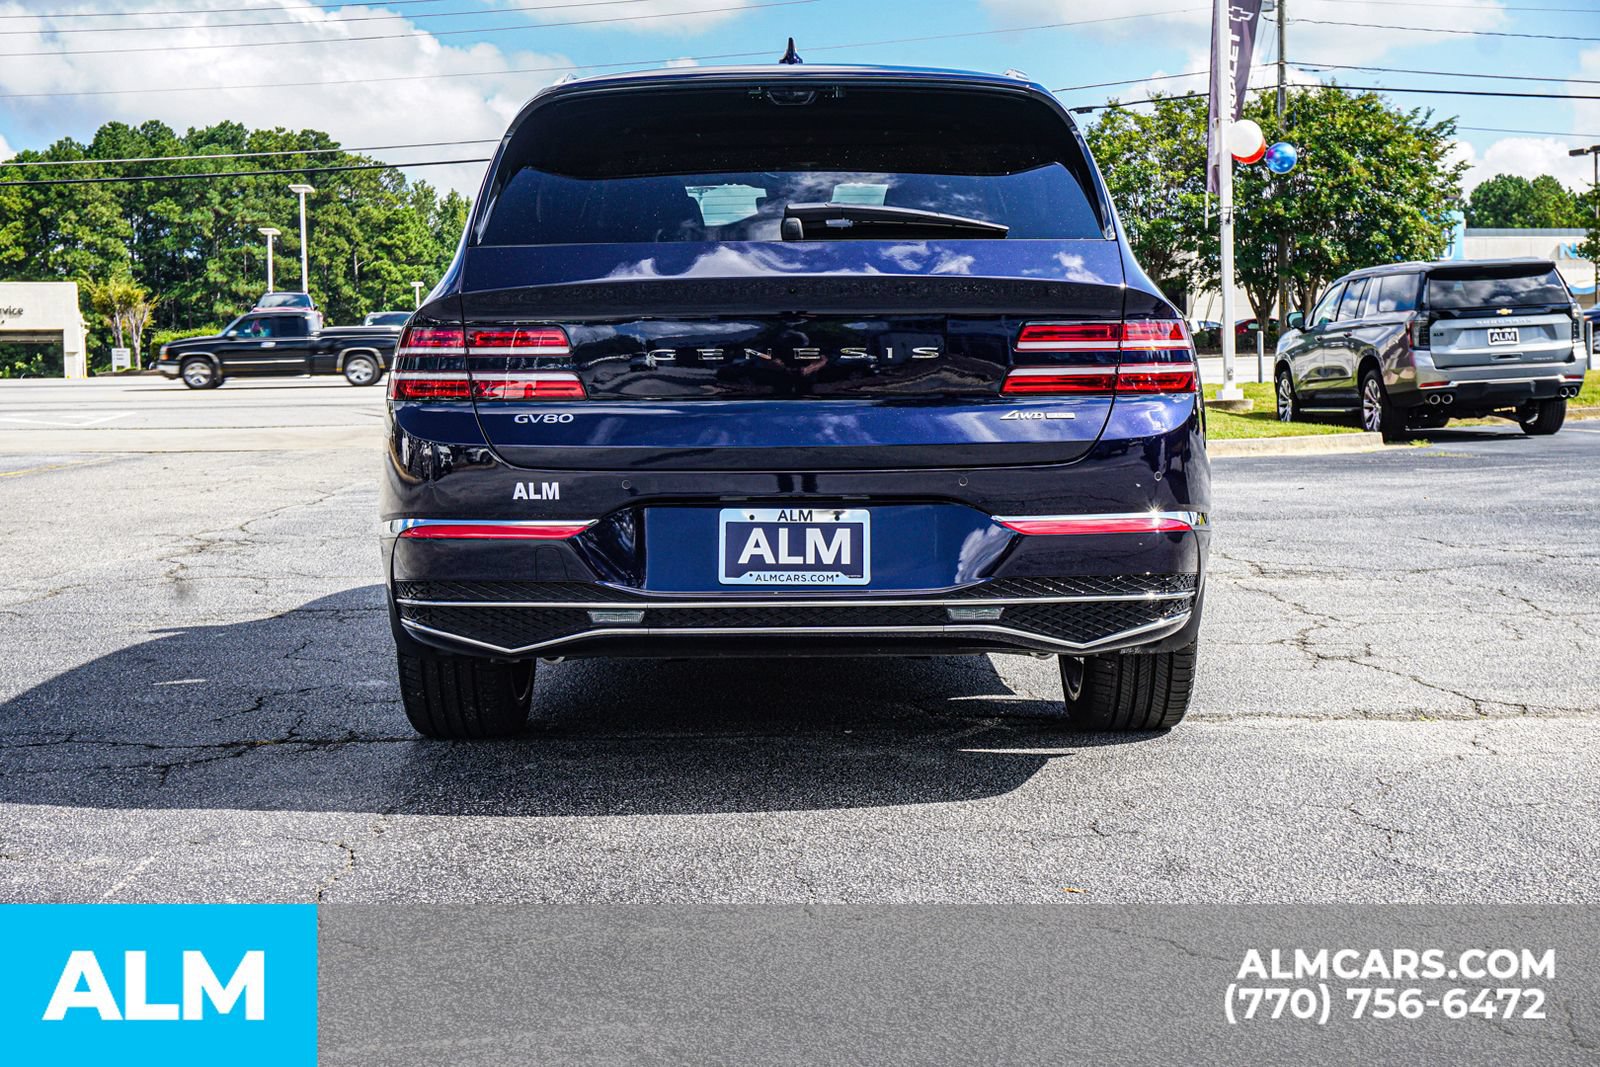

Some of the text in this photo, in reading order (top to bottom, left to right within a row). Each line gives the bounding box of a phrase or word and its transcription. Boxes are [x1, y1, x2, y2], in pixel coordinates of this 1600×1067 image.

[1492, 332, 1515, 342] ALM
[646, 347, 939, 361] GENESIS
[513, 413, 575, 424] GV80
[512, 482, 560, 500] ALM
[777, 509, 813, 522] ALM
[737, 527, 851, 565] ALM
[755, 573, 835, 583] ALMCARS.COM
